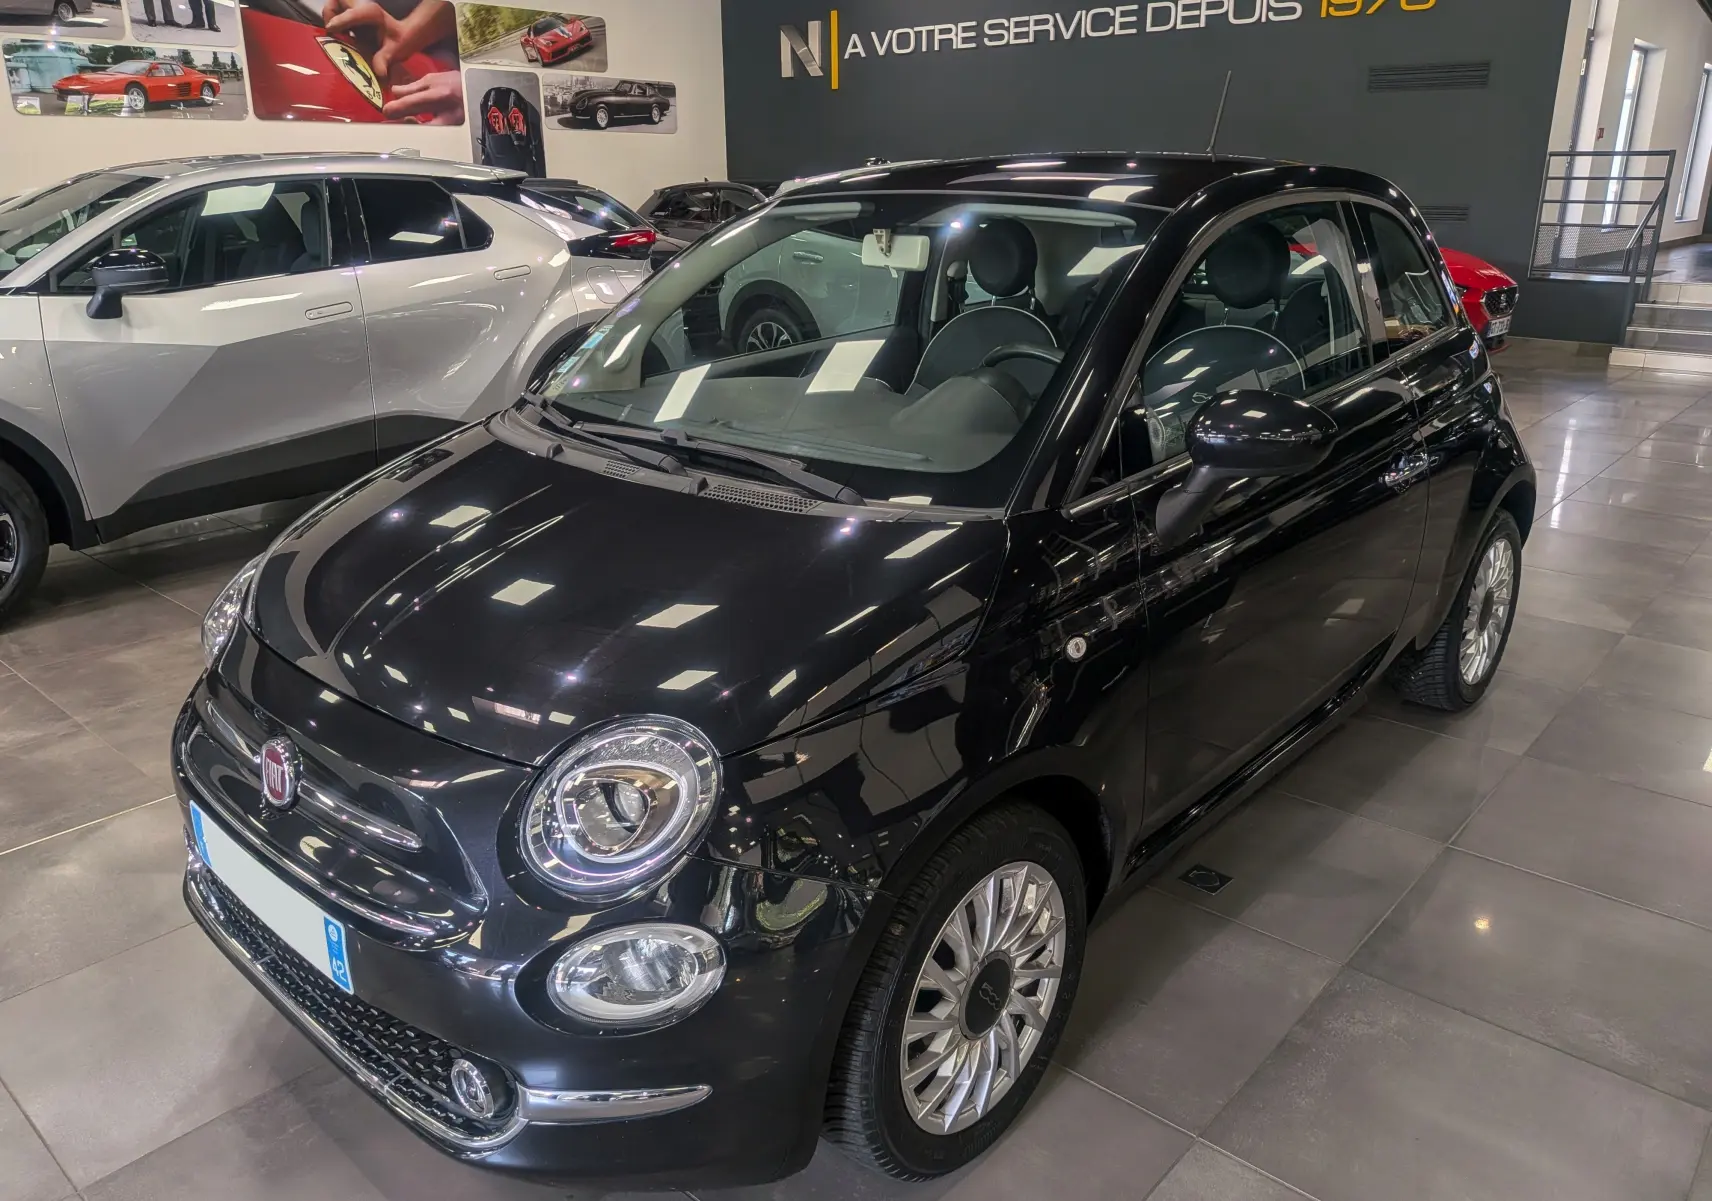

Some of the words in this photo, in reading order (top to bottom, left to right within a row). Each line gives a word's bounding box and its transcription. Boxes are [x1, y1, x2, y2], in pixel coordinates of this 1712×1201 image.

[843, 33, 867, 59] A
[871, 20, 978, 56] VOTRE
[983, 4, 1140, 47] SERVICE
[1145, 0, 1303, 32] DEPUIS
[265, 757, 284, 793] FIAT
